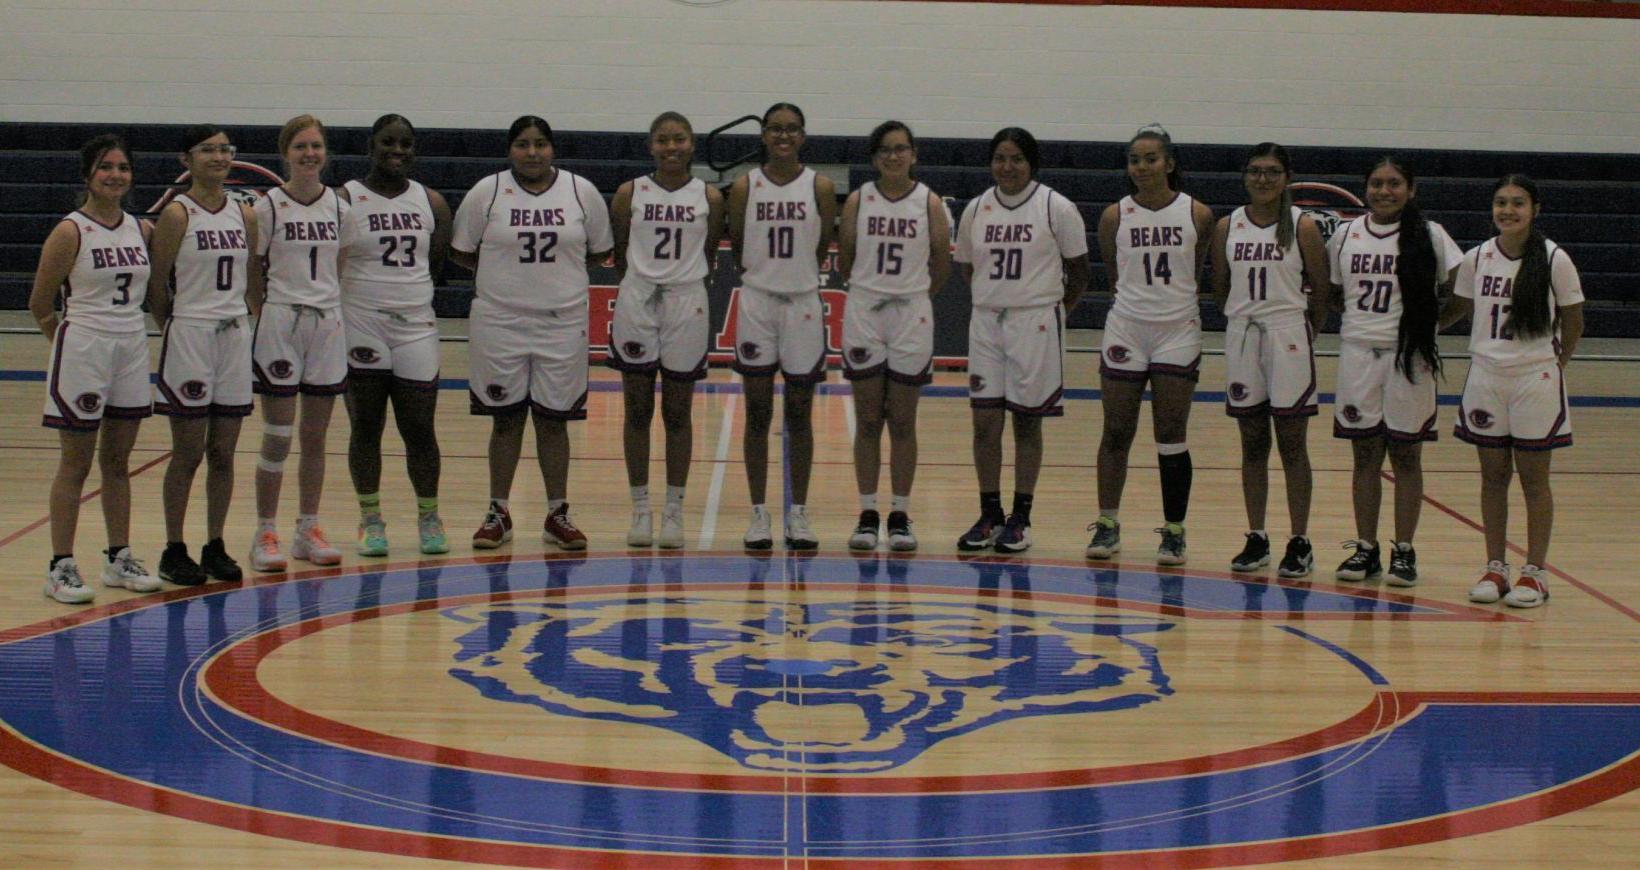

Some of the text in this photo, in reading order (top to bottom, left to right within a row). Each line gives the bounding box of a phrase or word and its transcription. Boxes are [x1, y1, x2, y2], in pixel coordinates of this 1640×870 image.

[368, 213, 422, 231] BEARS
[510, 209, 564, 226] BEARS
[644, 204, 695, 222] BEARS
[757, 202, 805, 221] BEARS
[285, 222, 338, 241] BEARS
[868, 217, 916, 238] BEARS
[985, 225, 1032, 242] BEARS
[1131, 227, 1182, 247] BEARS
[196, 230, 247, 250] BEARS
[380, 236, 417, 267] 23
[518, 232, 557, 263] 32
[654, 227, 682, 259] 21
[768, 227, 793, 258] 10
[1234, 242, 1284, 261] BEARS
[93, 246, 148, 269] BEARS
[309, 246, 317, 280] 1
[878, 243, 903, 275] 15
[990, 249, 1022, 280] 30
[1143, 252, 1171, 285] 14
[1351, 254, 1399, 275] BEAR
[217, 256, 234, 291] 0
[1248, 267, 1266, 300] 11
[113, 273, 133, 305] 3
[1358, 280, 1392, 313] 20
[1482, 276, 1513, 298] BEA
